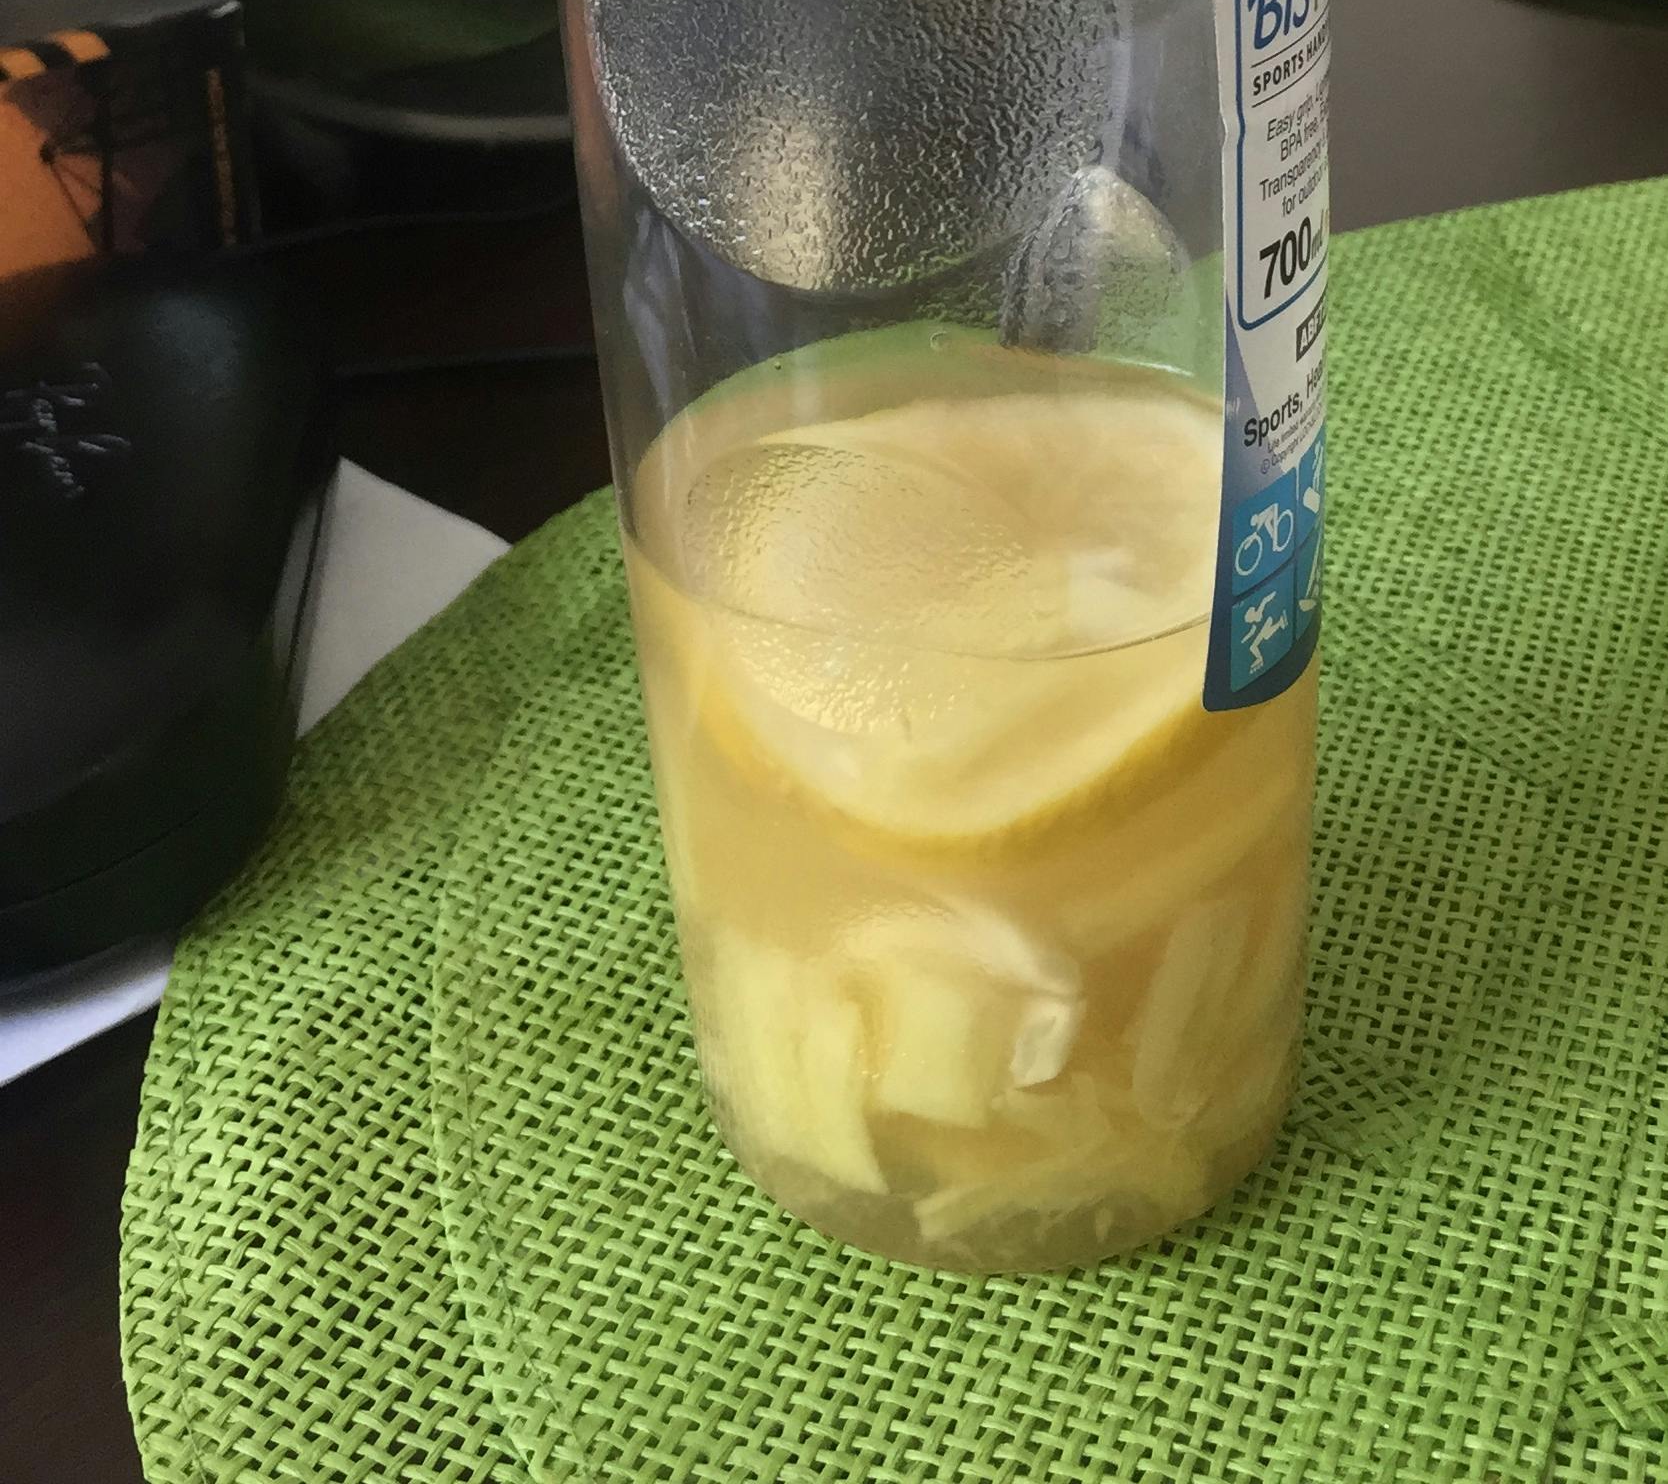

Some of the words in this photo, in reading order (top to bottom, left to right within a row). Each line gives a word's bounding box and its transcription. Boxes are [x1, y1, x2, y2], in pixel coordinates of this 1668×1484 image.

[1253, 49, 1304, 96] SPORTS
[1267, 111, 1295, 142] Easy
[1281, 129, 1302, 162] BPA
[1282, 194, 1296, 217] for
[1244, 392, 1303, 447] Sports,
